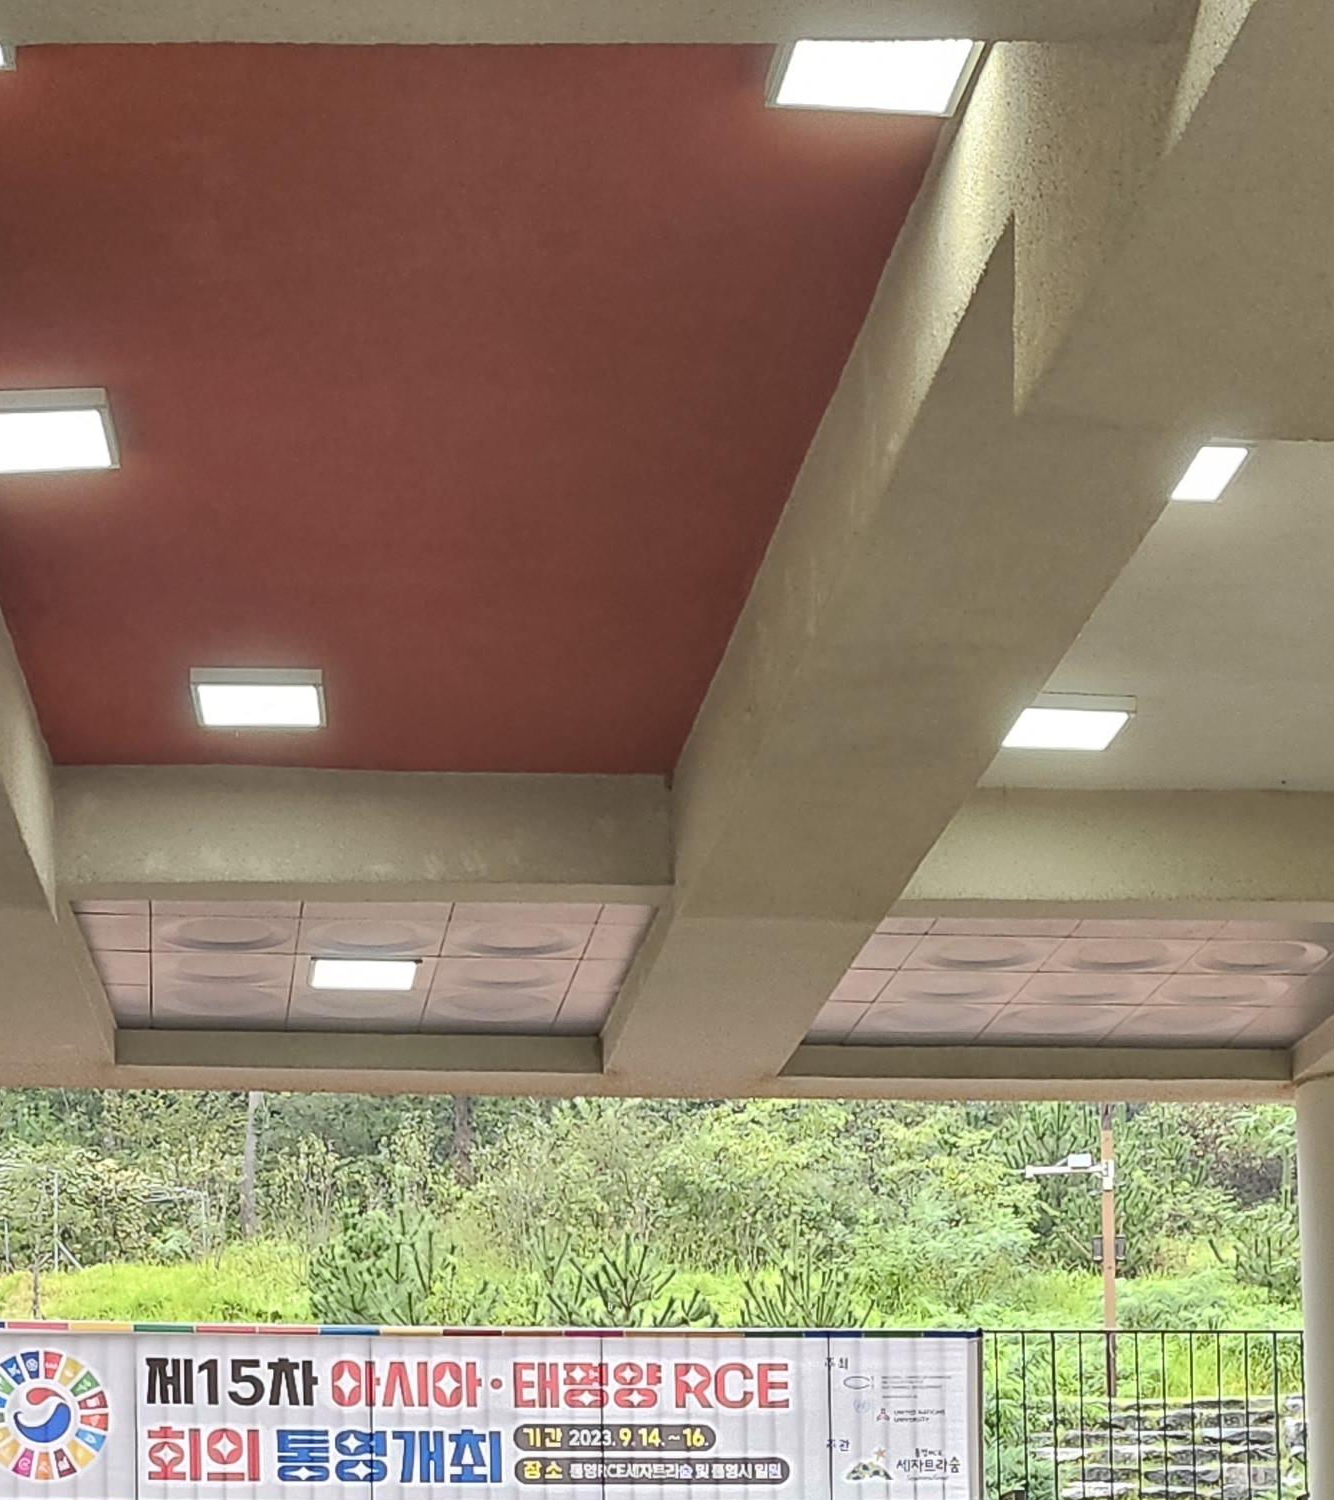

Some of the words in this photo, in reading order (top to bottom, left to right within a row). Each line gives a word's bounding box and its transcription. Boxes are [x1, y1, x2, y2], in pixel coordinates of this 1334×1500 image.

[145, 1357, 319, 1406] 제15차
[330, 1360, 662, 1409] 아시아·태평양
[673, 1362, 790, 1409] RCE
[147, 1426, 260, 1481] 회의
[275, 1429, 502, 1484] 통영개최
[568, 1429, 616, 1447] 2023.
[682, 1427, 709, 1447] 16.
